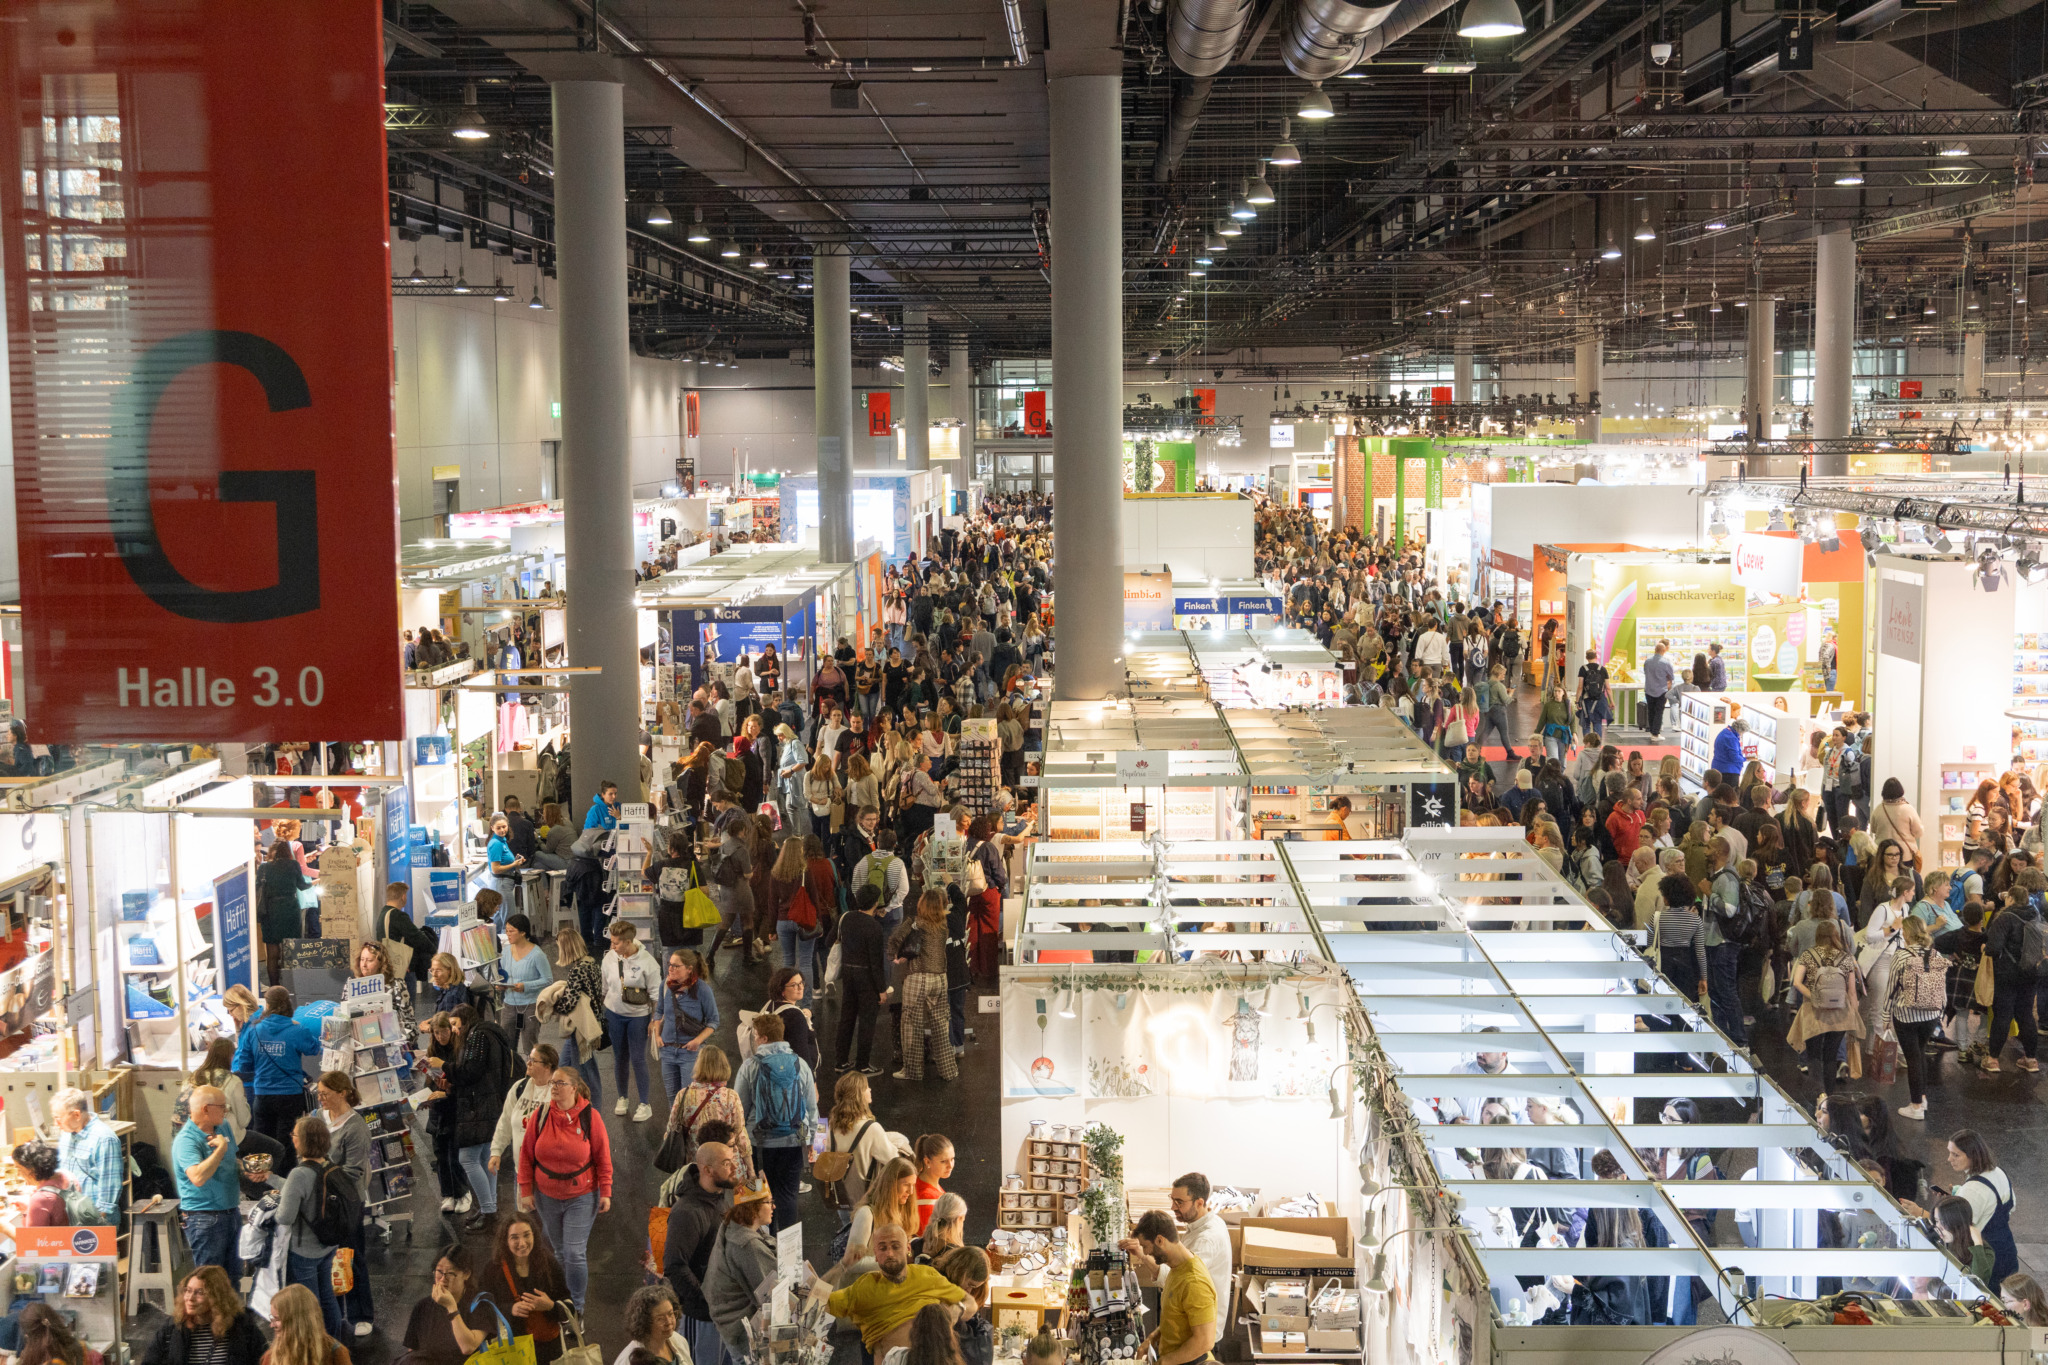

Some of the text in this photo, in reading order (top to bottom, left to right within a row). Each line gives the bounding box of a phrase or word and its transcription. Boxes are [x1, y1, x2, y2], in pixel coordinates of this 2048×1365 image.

[873, 411, 886, 430] H
[1029, 411, 1042, 428] G
[106, 330, 321, 623] G
[1646, 590, 1736, 602] hauschkaverlag
[1184, 602, 1211, 610] Finken
[1238, 601, 1265, 610] Finken
[714, 610, 741, 620] NCK
[1886, 625, 1914, 645] INTENSE
[118, 665, 324, 708] Halle 3.0
[421, 745, 441, 756] Häft
[225, 902, 247, 933] Häfft
[351, 978, 383, 997] Häfft
[37, 1238, 50, 1247] We
